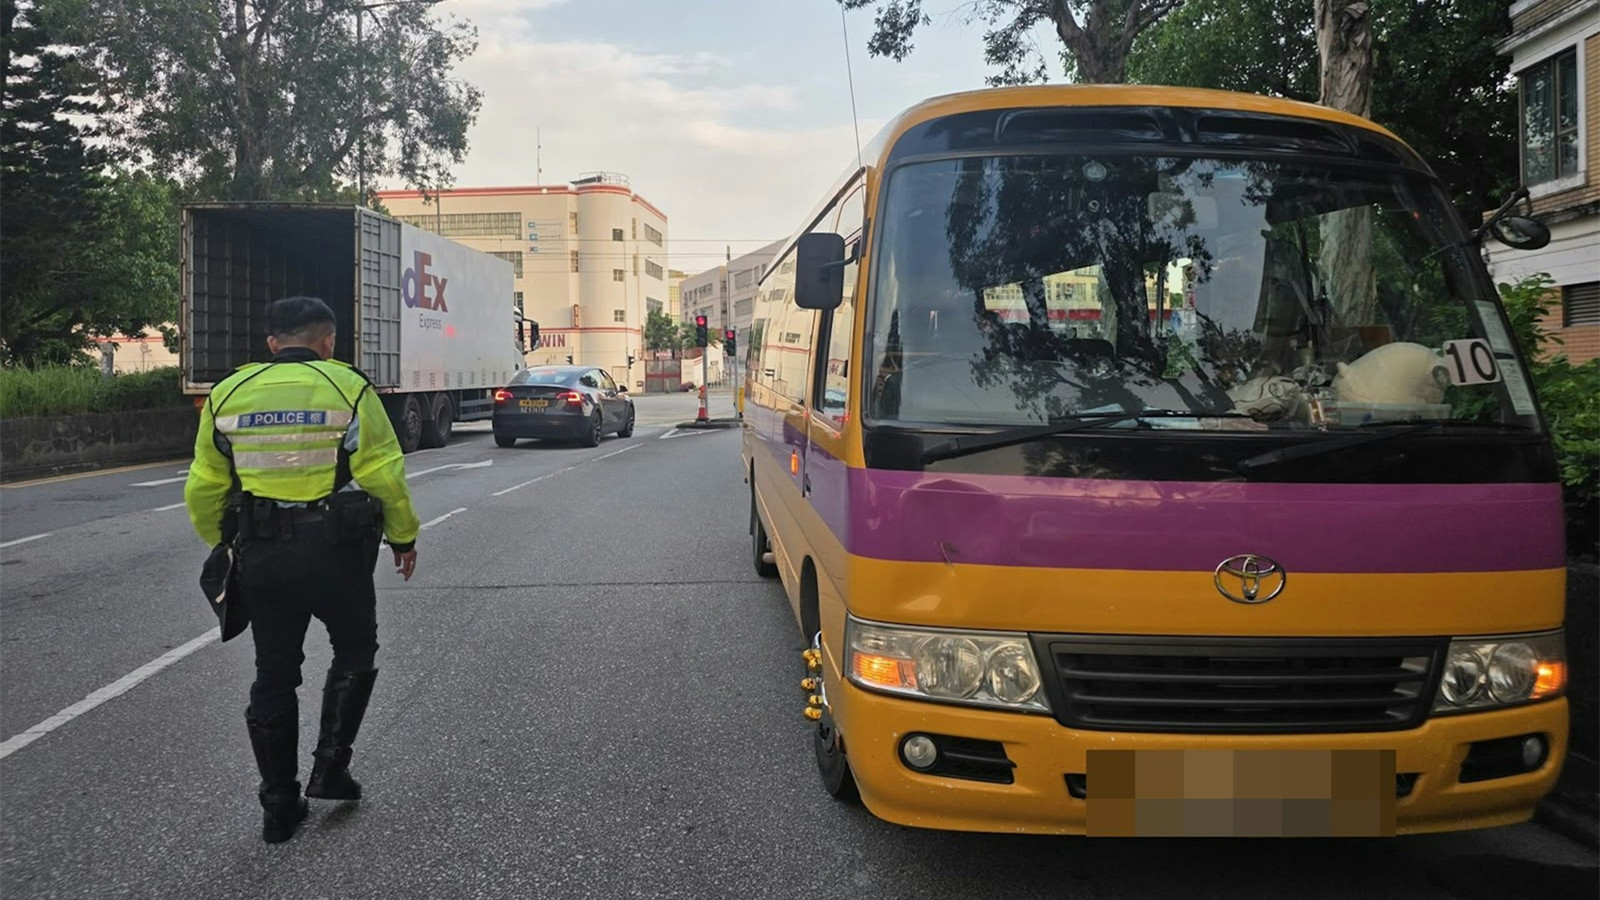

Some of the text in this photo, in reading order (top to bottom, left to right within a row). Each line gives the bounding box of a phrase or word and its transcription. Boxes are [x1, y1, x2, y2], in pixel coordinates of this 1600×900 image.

[402, 250, 448, 312] dEx
[419, 313, 442, 332] Express
[1445, 341, 1497, 383] 10
[255, 412, 305, 425] POLICE
